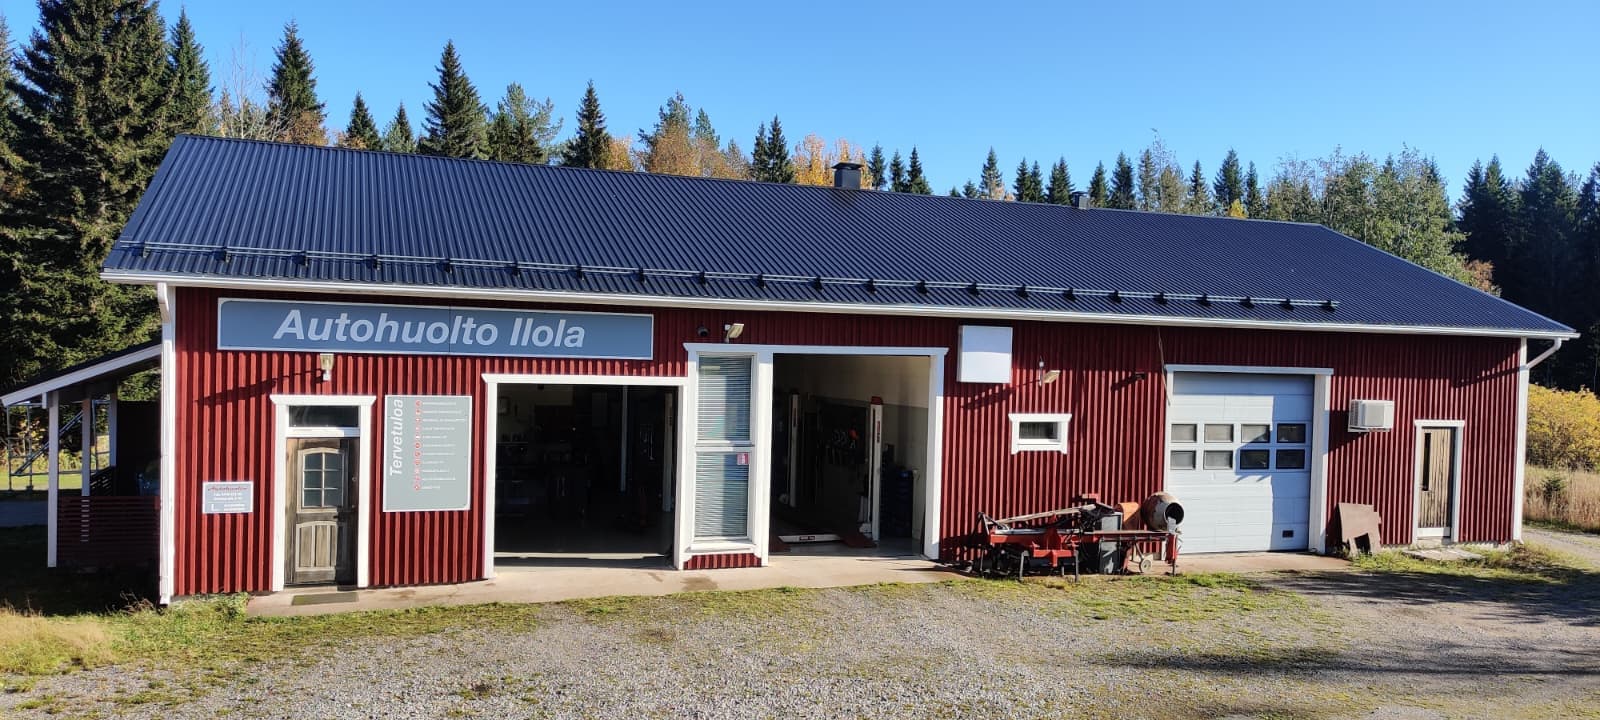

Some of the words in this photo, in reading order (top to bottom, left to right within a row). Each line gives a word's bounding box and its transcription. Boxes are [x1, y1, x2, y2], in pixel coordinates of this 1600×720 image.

[273, 309, 498, 345] Autohuolto
[509, 317, 586, 348] Ilola
[389, 399, 403, 476] Tervetuloa
